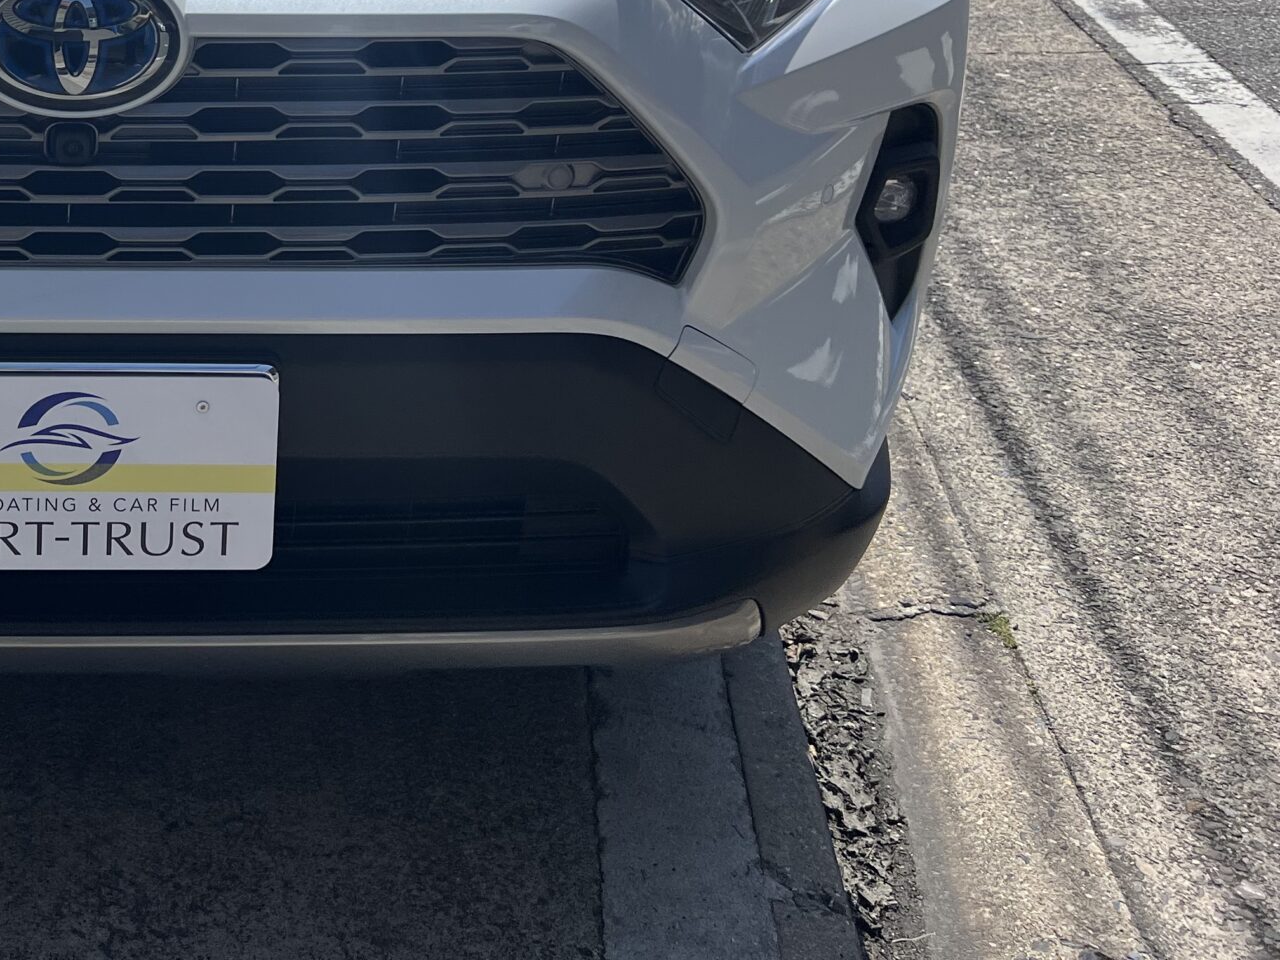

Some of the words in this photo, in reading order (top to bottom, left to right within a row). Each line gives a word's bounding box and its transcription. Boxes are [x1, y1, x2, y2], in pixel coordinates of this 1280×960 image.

[88, 497, 102, 513] &
[113, 497, 158, 513] CAR
[169, 497, 220, 513] FILM
